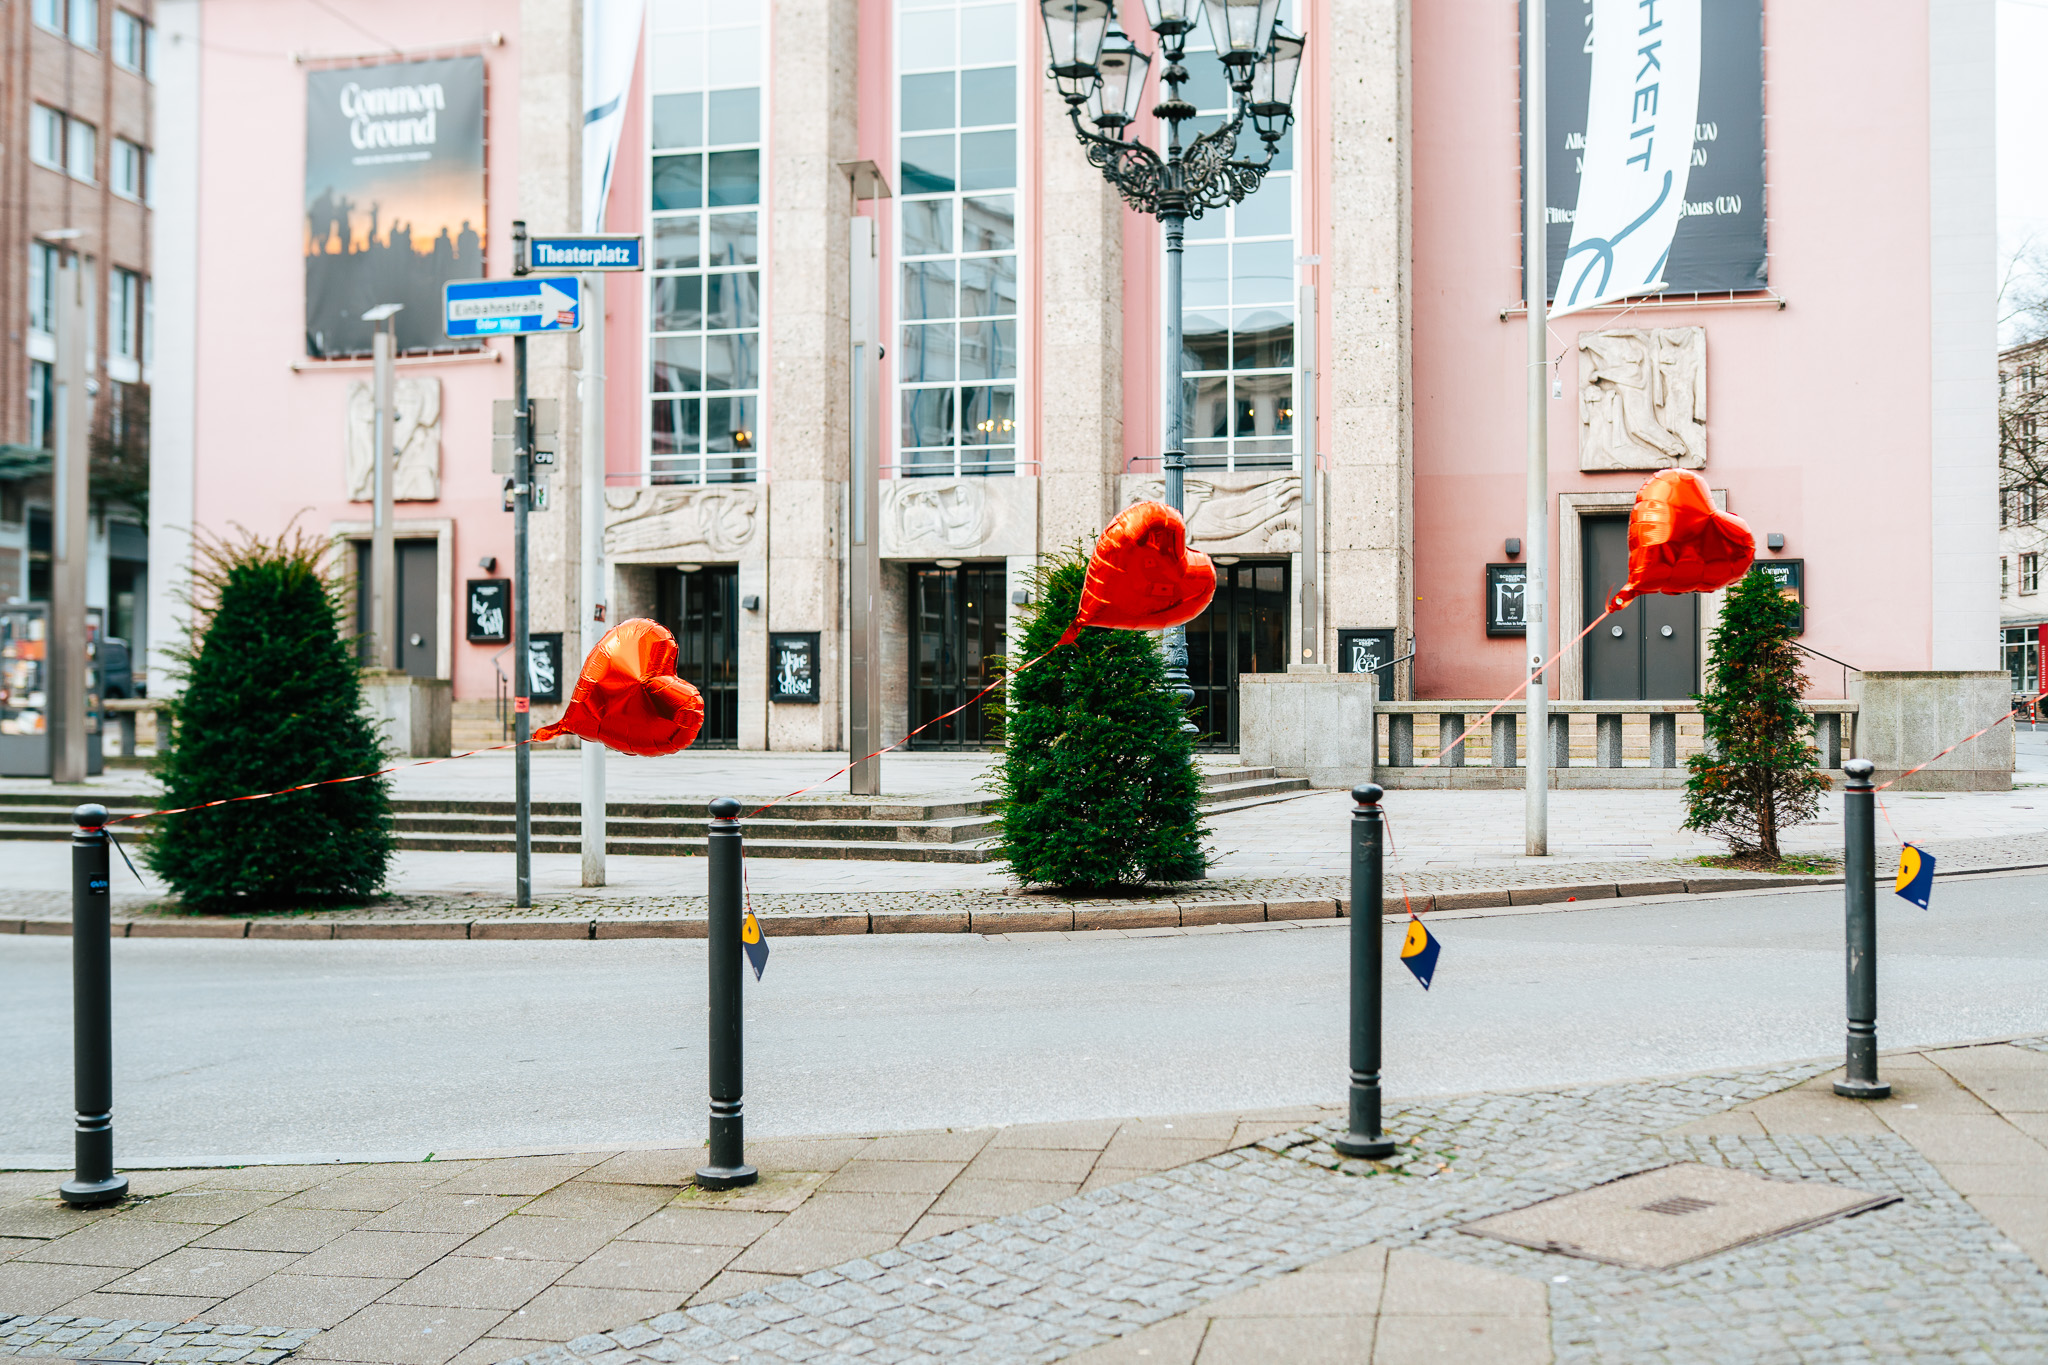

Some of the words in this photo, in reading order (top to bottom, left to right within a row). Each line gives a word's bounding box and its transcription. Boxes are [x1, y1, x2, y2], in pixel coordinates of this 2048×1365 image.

[340, 82, 446, 118] Common
[350, 109, 437, 150] Ground
[537, 244, 630, 267] Theaterplatz
[455, 300, 544, 316] Einbahnstraße
[1762, 567, 1789, 575] Common
[1352, 646, 1380, 673] Peer
